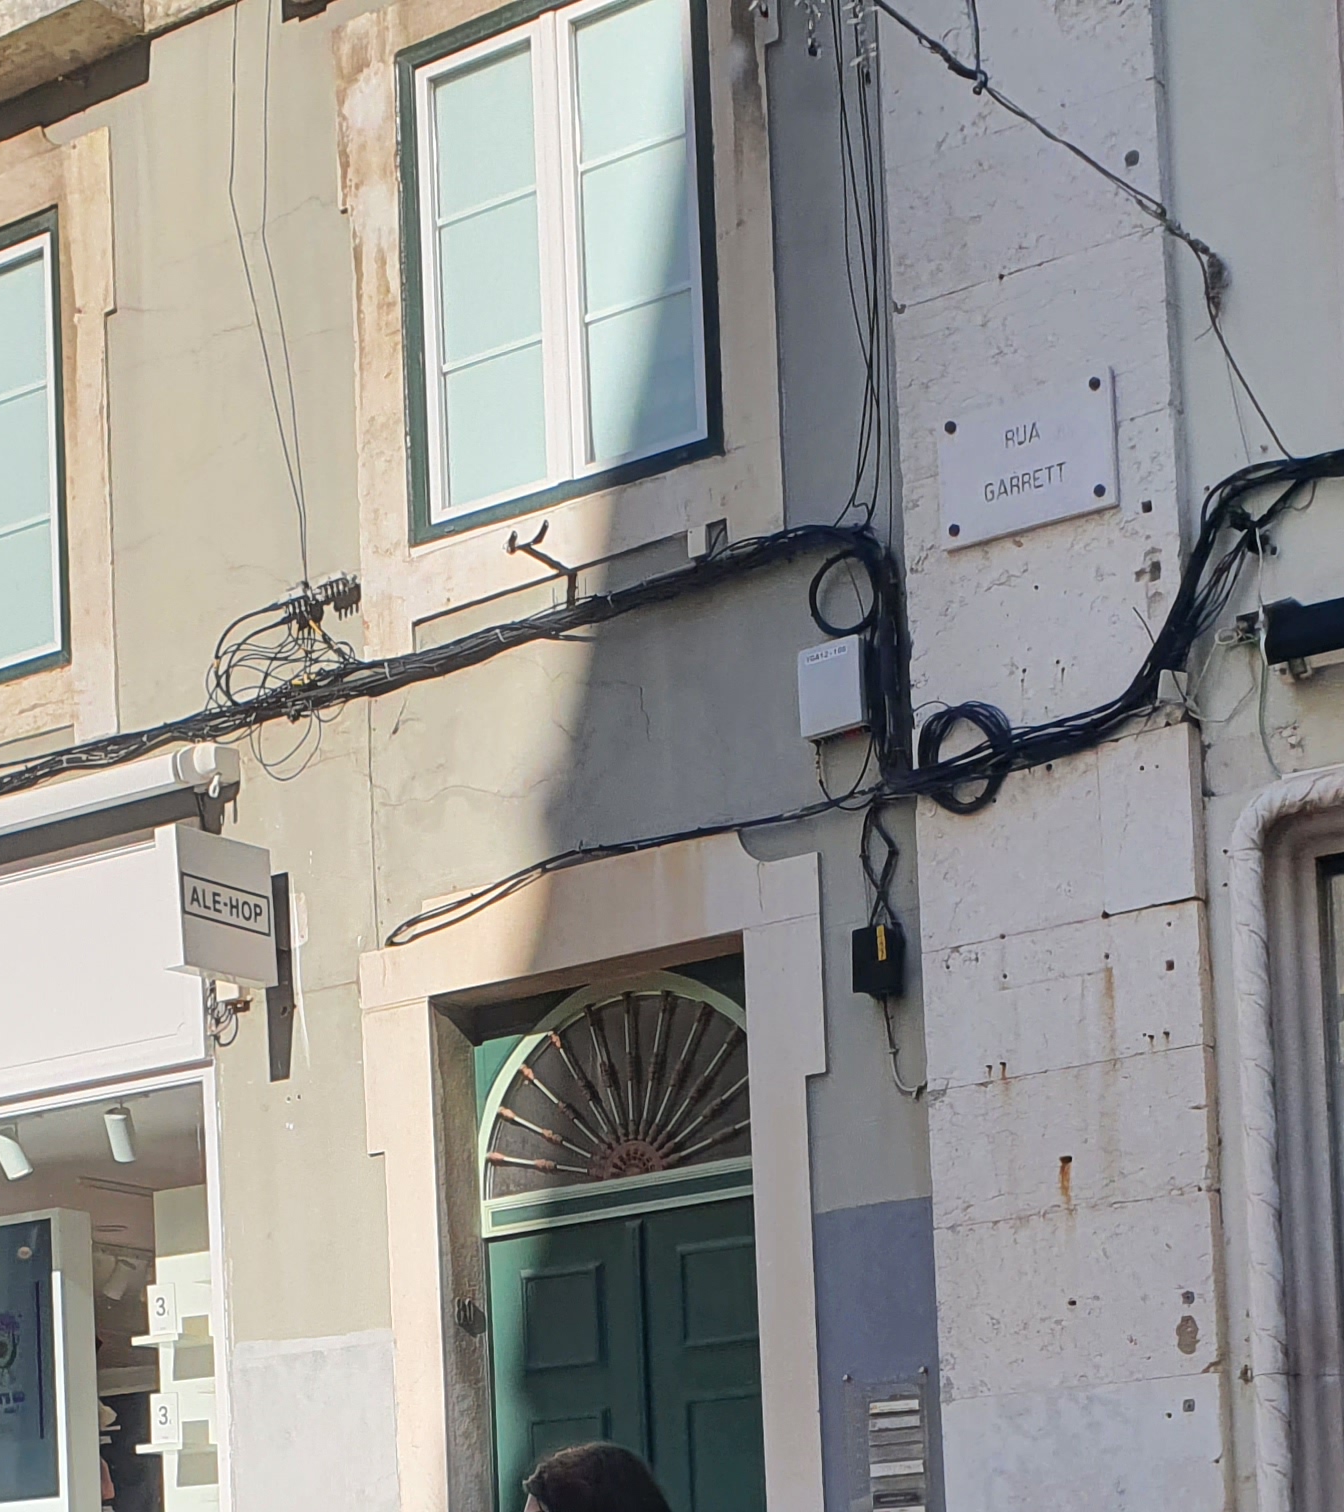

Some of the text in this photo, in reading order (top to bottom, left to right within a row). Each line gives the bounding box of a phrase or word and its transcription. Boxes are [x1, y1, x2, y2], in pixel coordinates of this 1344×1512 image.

[1005, 422, 1041, 448] RUA
[984, 461, 1067, 502] GARRETT
[190, 885, 263, 923] ALE-HOP
